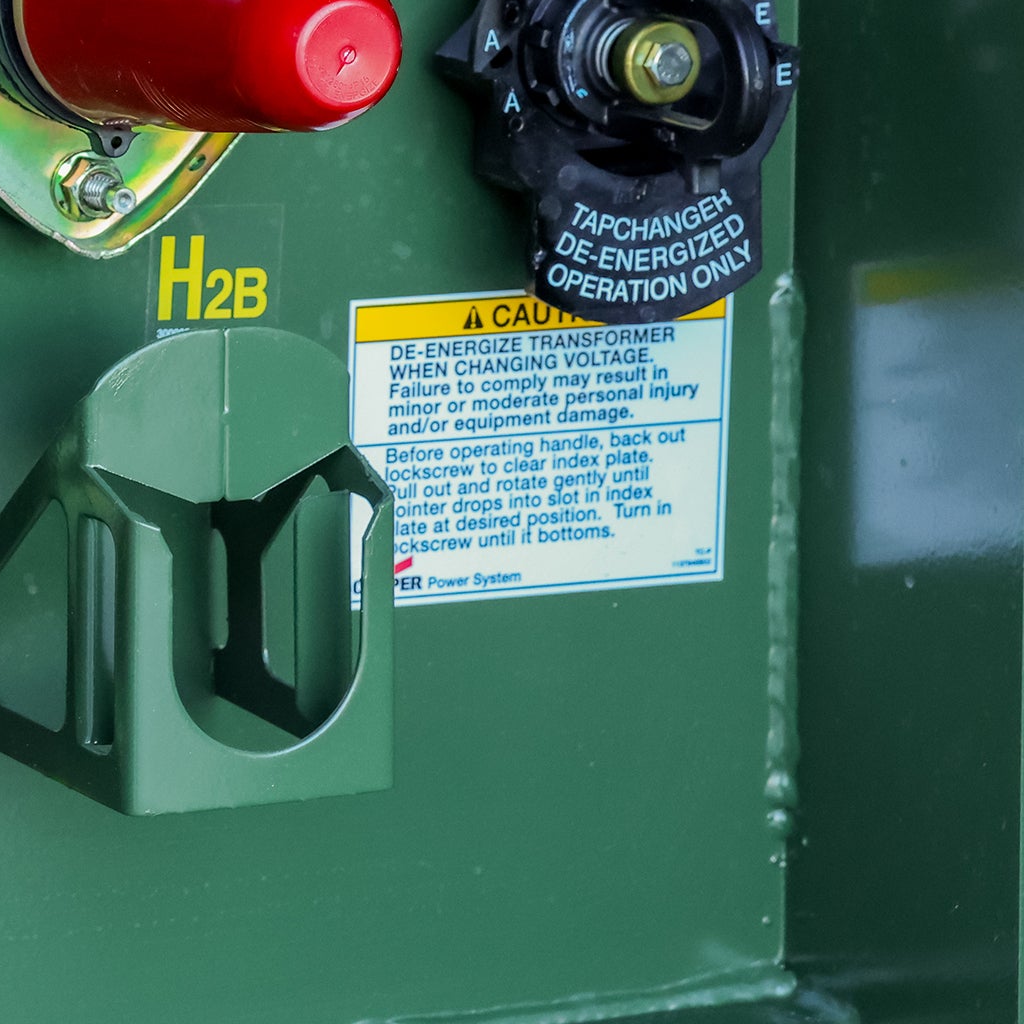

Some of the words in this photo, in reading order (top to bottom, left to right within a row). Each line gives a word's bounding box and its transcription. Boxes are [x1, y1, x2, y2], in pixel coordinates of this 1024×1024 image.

[755, 1, 772, 26] E
[484, 29, 501, 52] A
[777, 62, 793, 87] E
[503, 90, 521, 114] A
[555, 213, 745, 271] DE-ENERGIZED
[157, 235, 268, 321] H2B
[547, 263, 688, 303] OPERATION
[691, 239, 752, 289] ONLY
[390, 337, 522, 361] DE-ENERGIZE
[529, 326, 675, 351] TRANSFORMER
[389, 362, 448, 380] WHEN
[454, 354, 557, 376] CHANGING
[564, 348, 654, 368] VOLTAGE.
[389, 382, 451, 399] Failure
[457, 379, 475, 394] to
[481, 373, 547, 392] comply
[553, 373, 591, 388] may
[596, 367, 646, 384] result
[653, 364, 668, 380] in
[388, 401, 442, 418] minor
[447, 399, 466, 414] or
[472, 393, 559, 412] moderate
[566, 385, 643, 408] personal
[649, 382, 699, 401] injury
[388, 418, 449, 436] and/or
[454, 412, 552, 433] equipment
[557, 404, 635, 424] damage.
[385, 447, 444, 464] Before
[449, 441, 534, 461] operating
[540, 434, 604, 452] handle,
[610, 430, 652, 447] back
[657, 427, 686, 444] out
[385, 464, 475, 482] lockscrew
[480, 461, 498, 475] to
[503, 456, 547, 473] clear
[552, 453, 600, 470] index
[605, 450, 654, 468] plate.
[423, 482, 451, 498] out
[457, 477, 491, 495] and
[496, 475, 548, 492] rotate
[553, 470, 607, 490] gently
[612, 466, 650, 484] until
[395, 501, 447, 518] ointer
[452, 497, 503, 515] drops
[509, 493, 542, 509] into
[548, 489, 579, 506] slot
[585, 489, 600, 503] in
[606, 485, 654, 503] index
[395, 519, 427, 536] late
[433, 517, 450, 533] at
[455, 513, 521, 532] desired
[527, 507, 602, 527] position.
[613, 503, 651, 519] Turn
[657, 500, 672, 515] in
[394, 537, 473, 554] ckscrew
[478, 530, 516, 548] until
[521, 528, 532, 545] it
[537, 525, 616, 543] bottoms.
[428, 576, 469, 589] Power
